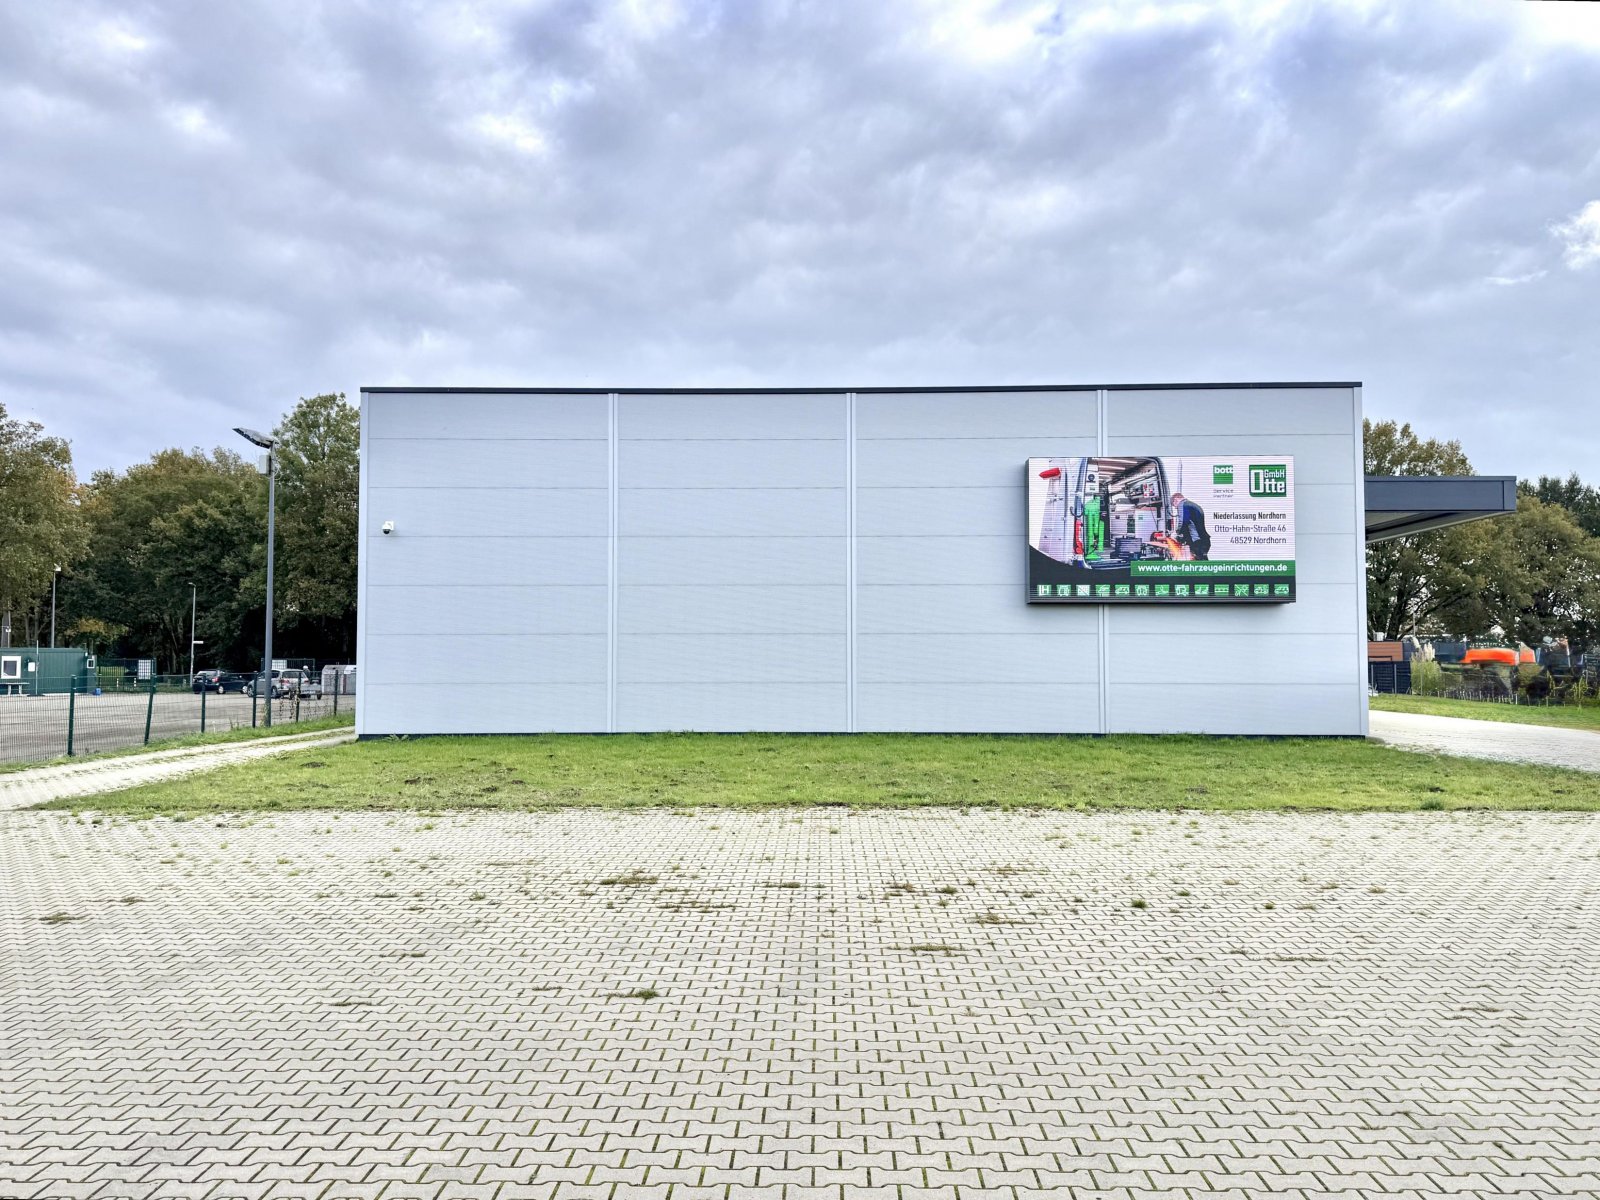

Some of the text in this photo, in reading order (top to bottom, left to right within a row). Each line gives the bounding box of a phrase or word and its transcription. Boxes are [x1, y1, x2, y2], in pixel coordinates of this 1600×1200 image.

[1214, 466, 1234, 474] bott
[1264, 469, 1285, 478] GmbH
[1250, 469, 1285, 493] Otte
[1213, 512, 1287, 521] Niederlassung Nordhorn
[1214, 524, 1287, 533] Otto-Hahn-Straße 46
[1230, 536, 1287, 544] 48529 Nordhorn
[1138, 563, 1288, 573] www.otte-fahrzeugeinrichtungen.de
